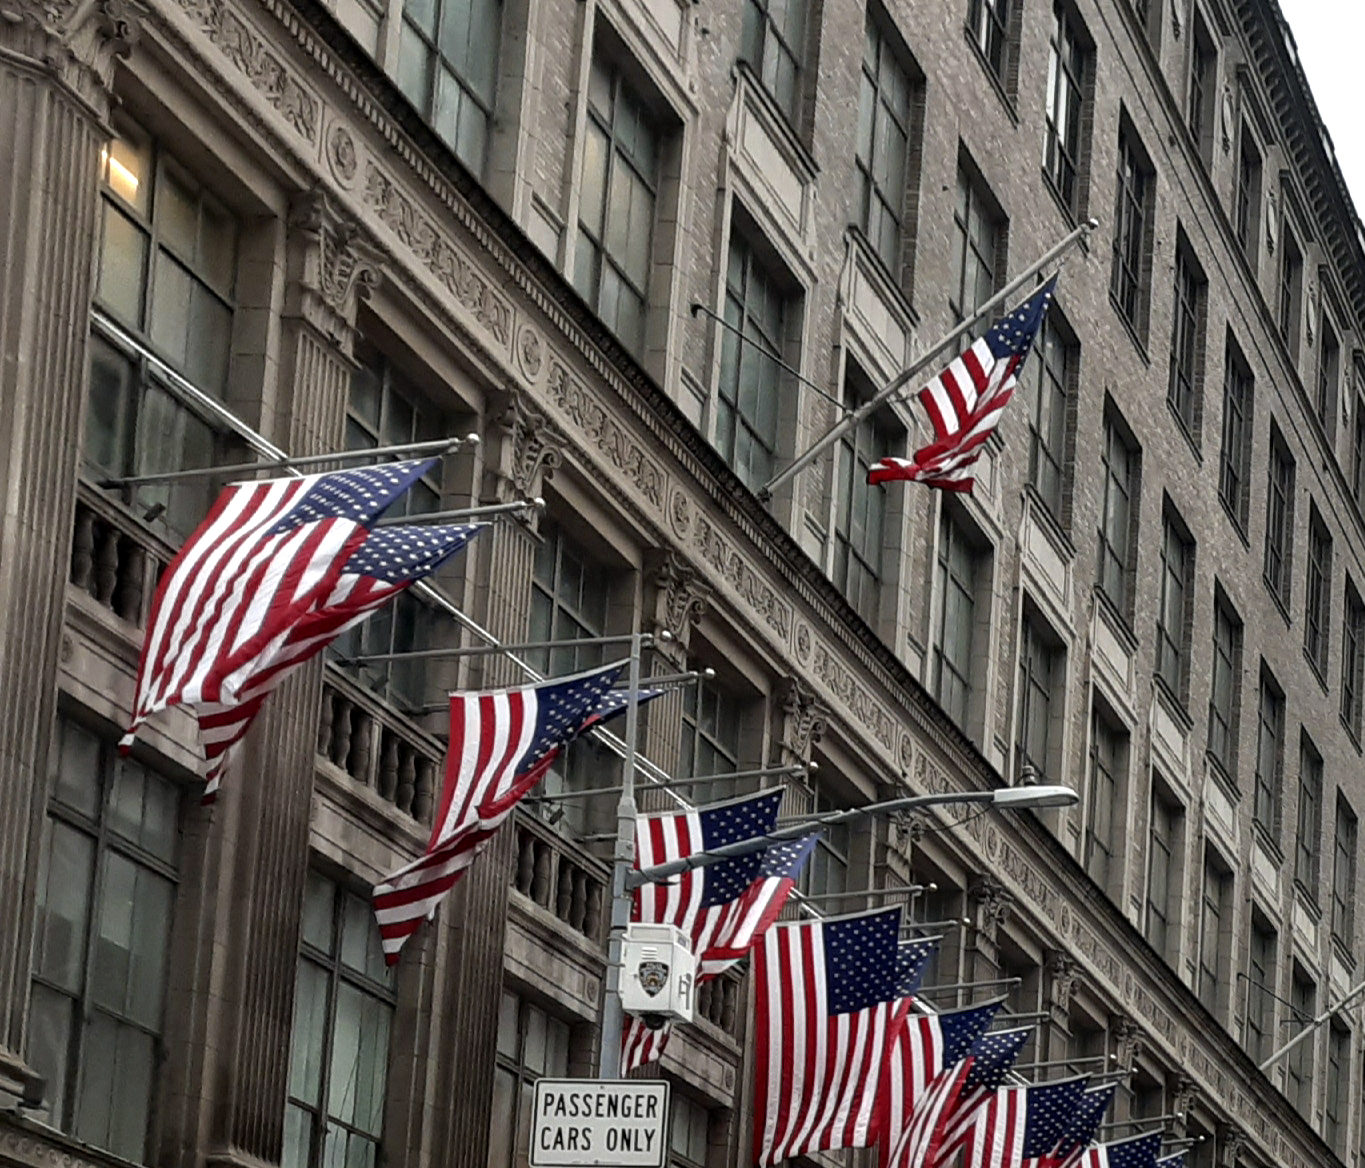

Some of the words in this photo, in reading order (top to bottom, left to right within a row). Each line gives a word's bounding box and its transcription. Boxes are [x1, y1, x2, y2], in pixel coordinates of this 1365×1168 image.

[543, 1092, 658, 1119] PASSENGER
[540, 1126, 592, 1151] CARS
[606, 1127, 656, 1152] ONLY
